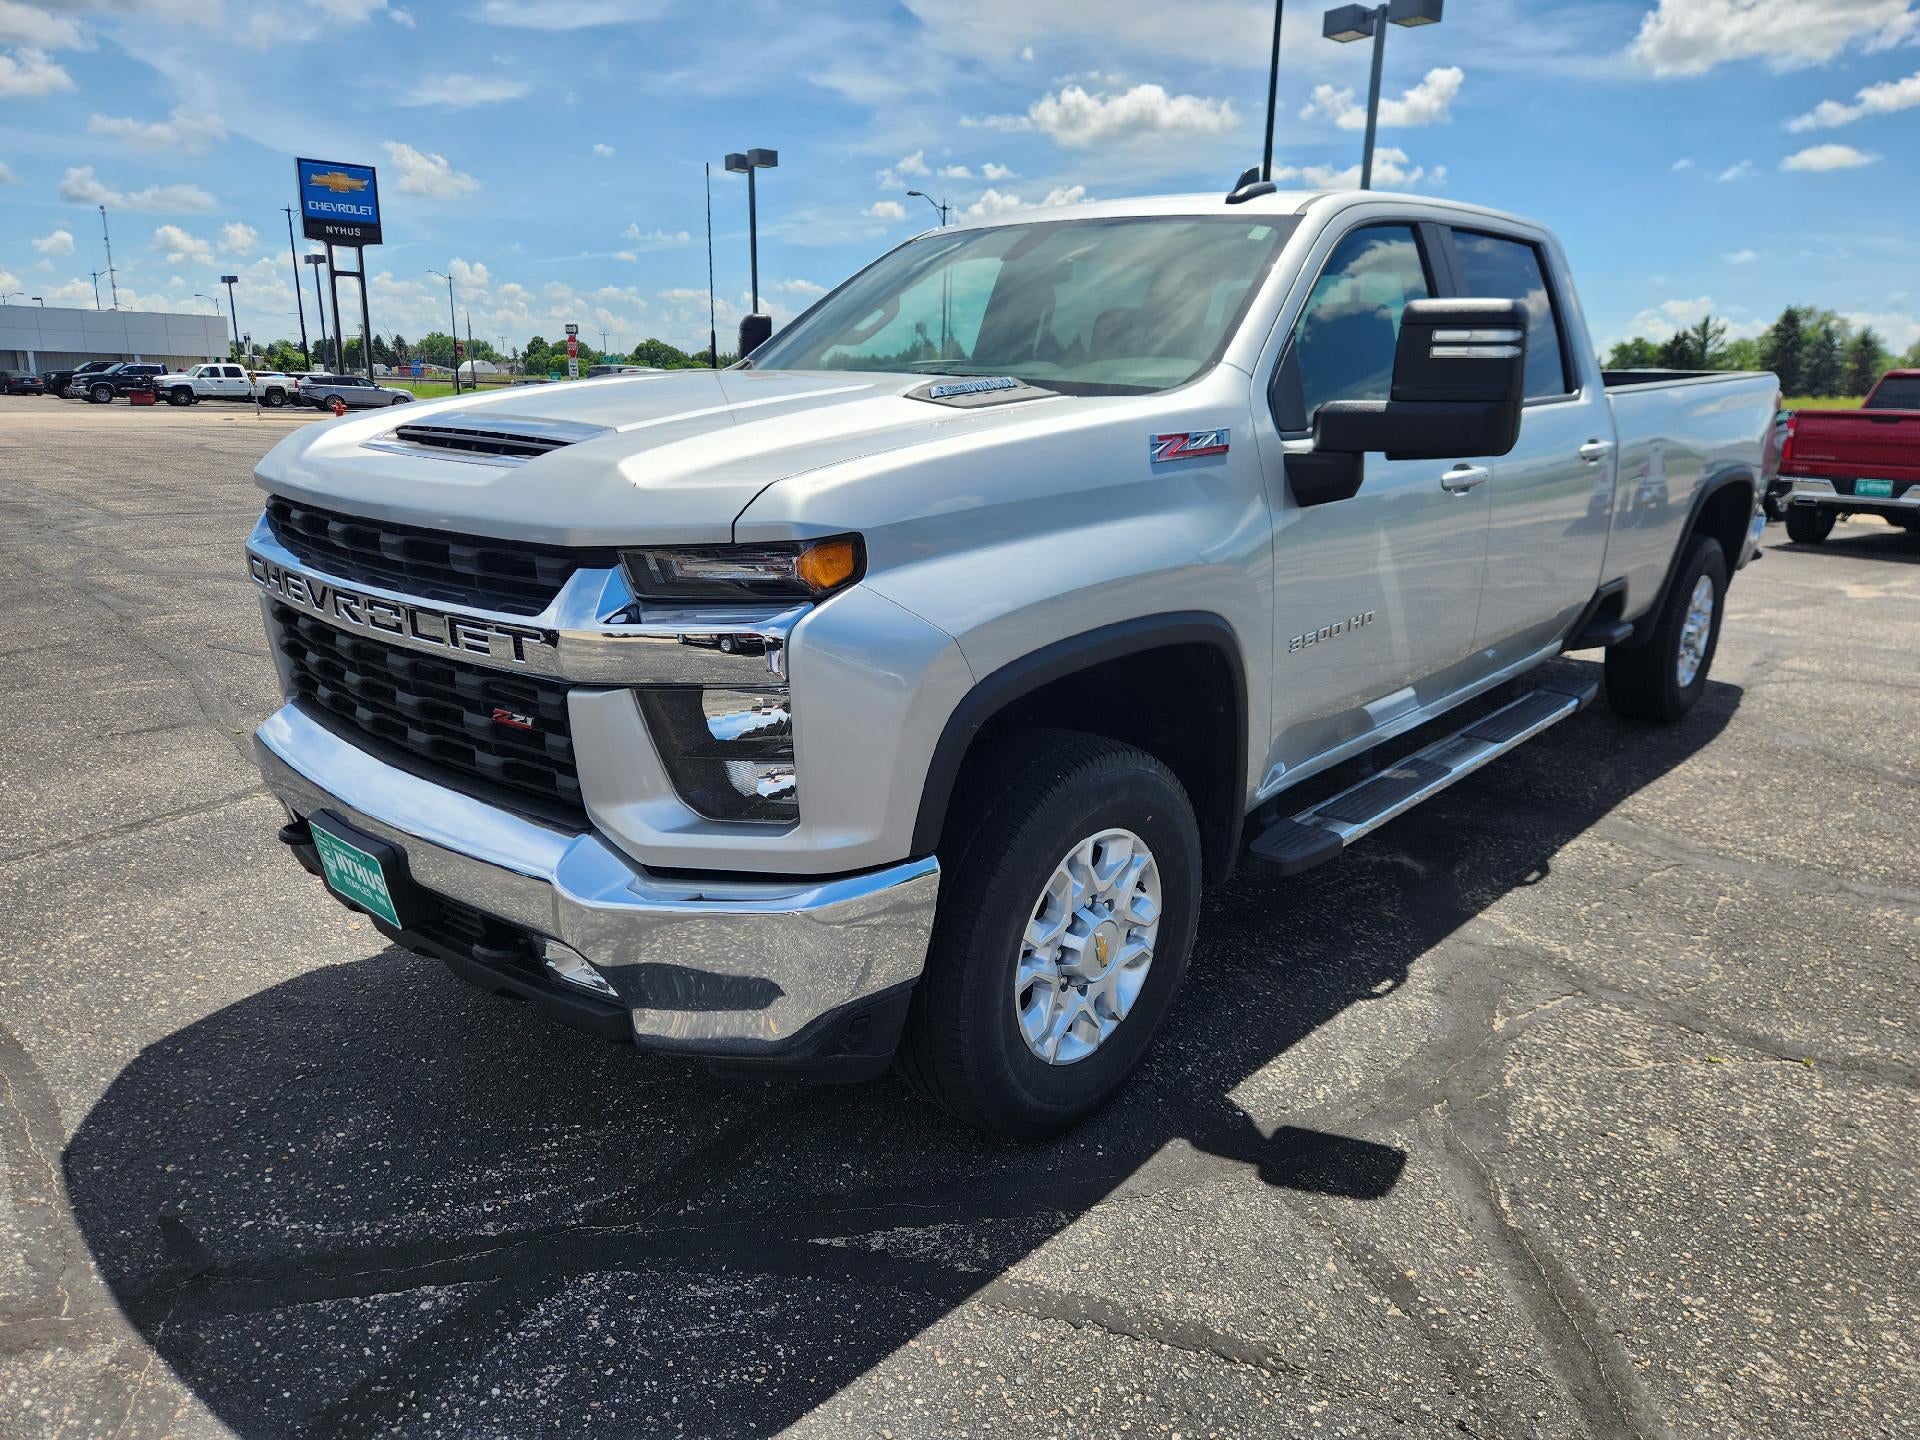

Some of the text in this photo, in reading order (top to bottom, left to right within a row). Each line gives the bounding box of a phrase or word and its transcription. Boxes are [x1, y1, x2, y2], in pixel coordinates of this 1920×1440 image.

[308, 200, 373, 215] CHEVROLET
[325, 225, 361, 236] NYHUS
[1150, 427, 1230, 463] Z71
[249, 554, 547, 664] CHEVROLET
[492, 707, 534, 730] Z71
[333, 850, 386, 897] NYHUS
